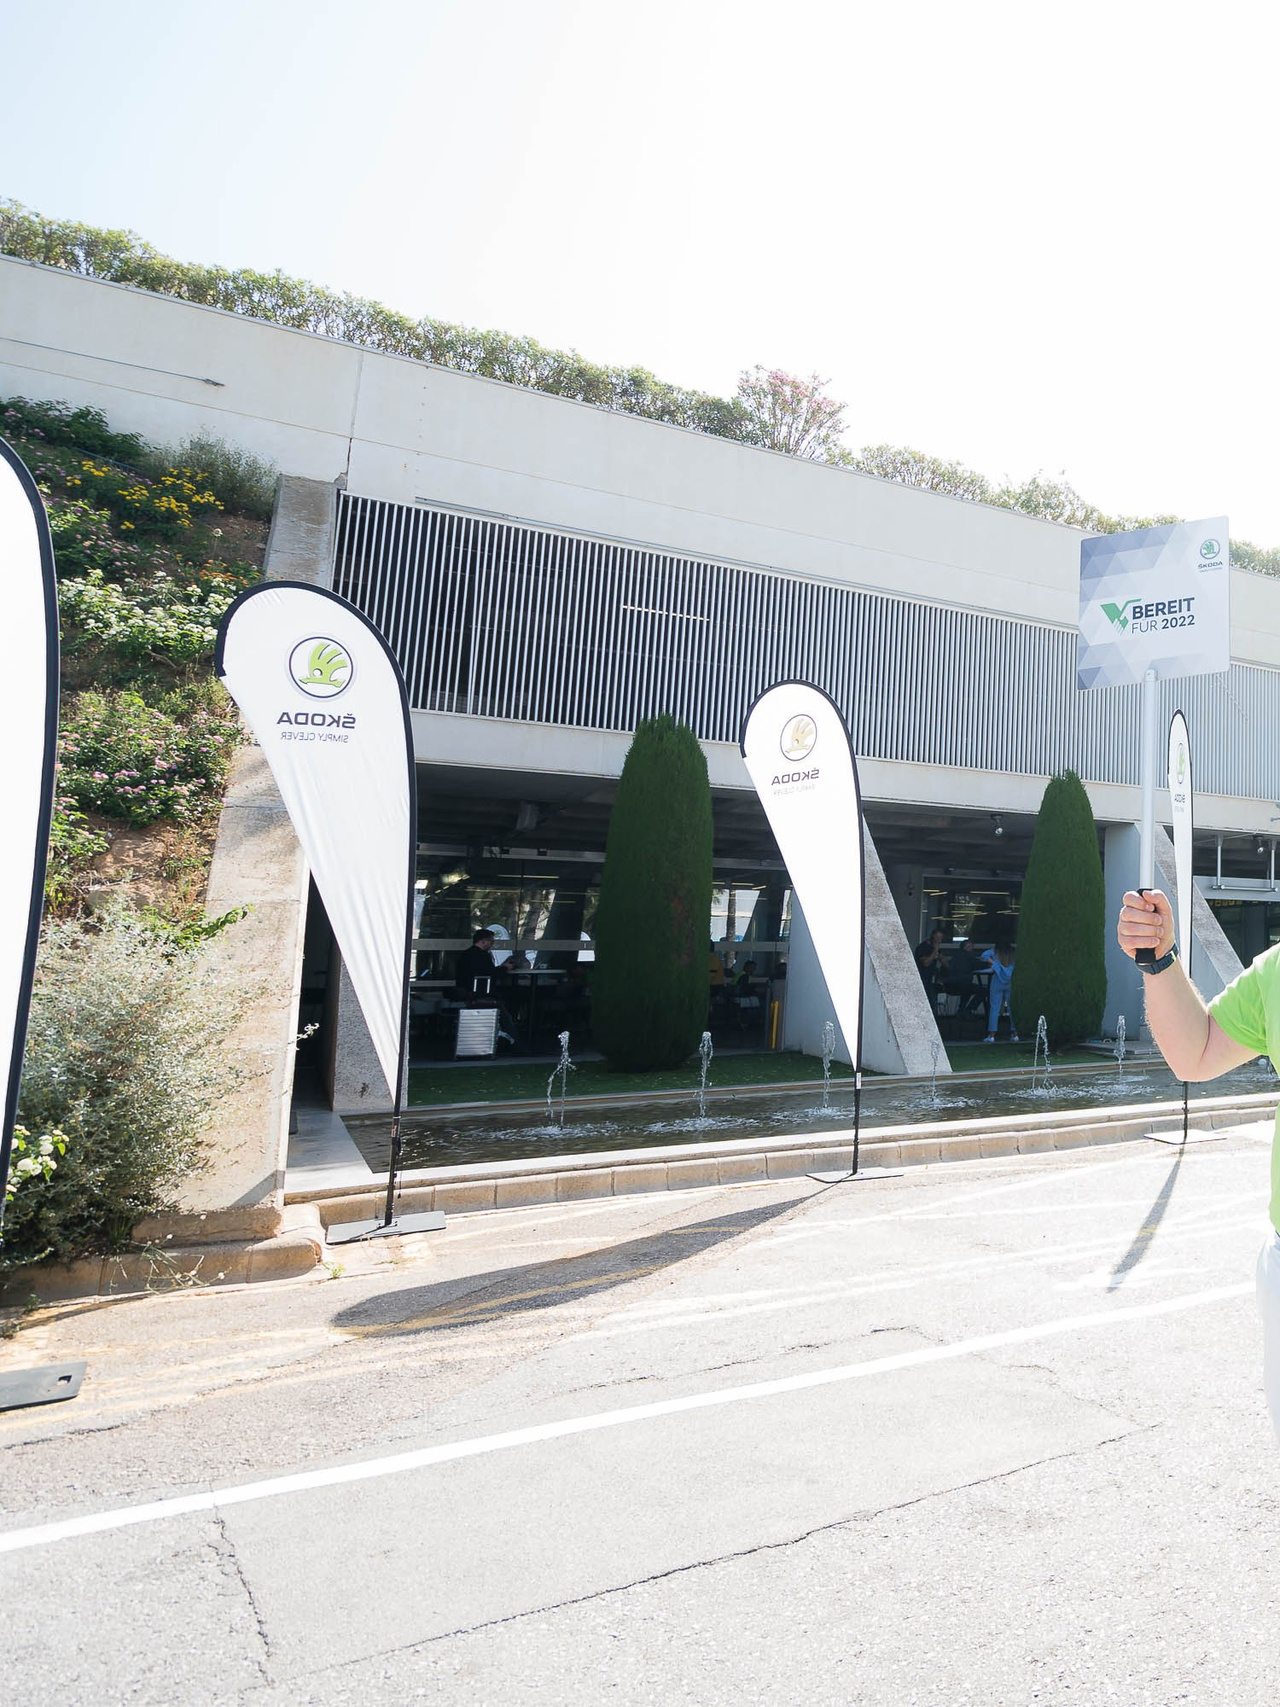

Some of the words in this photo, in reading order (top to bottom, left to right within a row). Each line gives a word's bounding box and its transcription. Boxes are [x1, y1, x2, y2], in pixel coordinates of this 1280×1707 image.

[1132, 597, 1195, 620] BEREIT
[1131, 618, 1158, 634] FÜR
[1161, 614, 1195, 630] 2022
